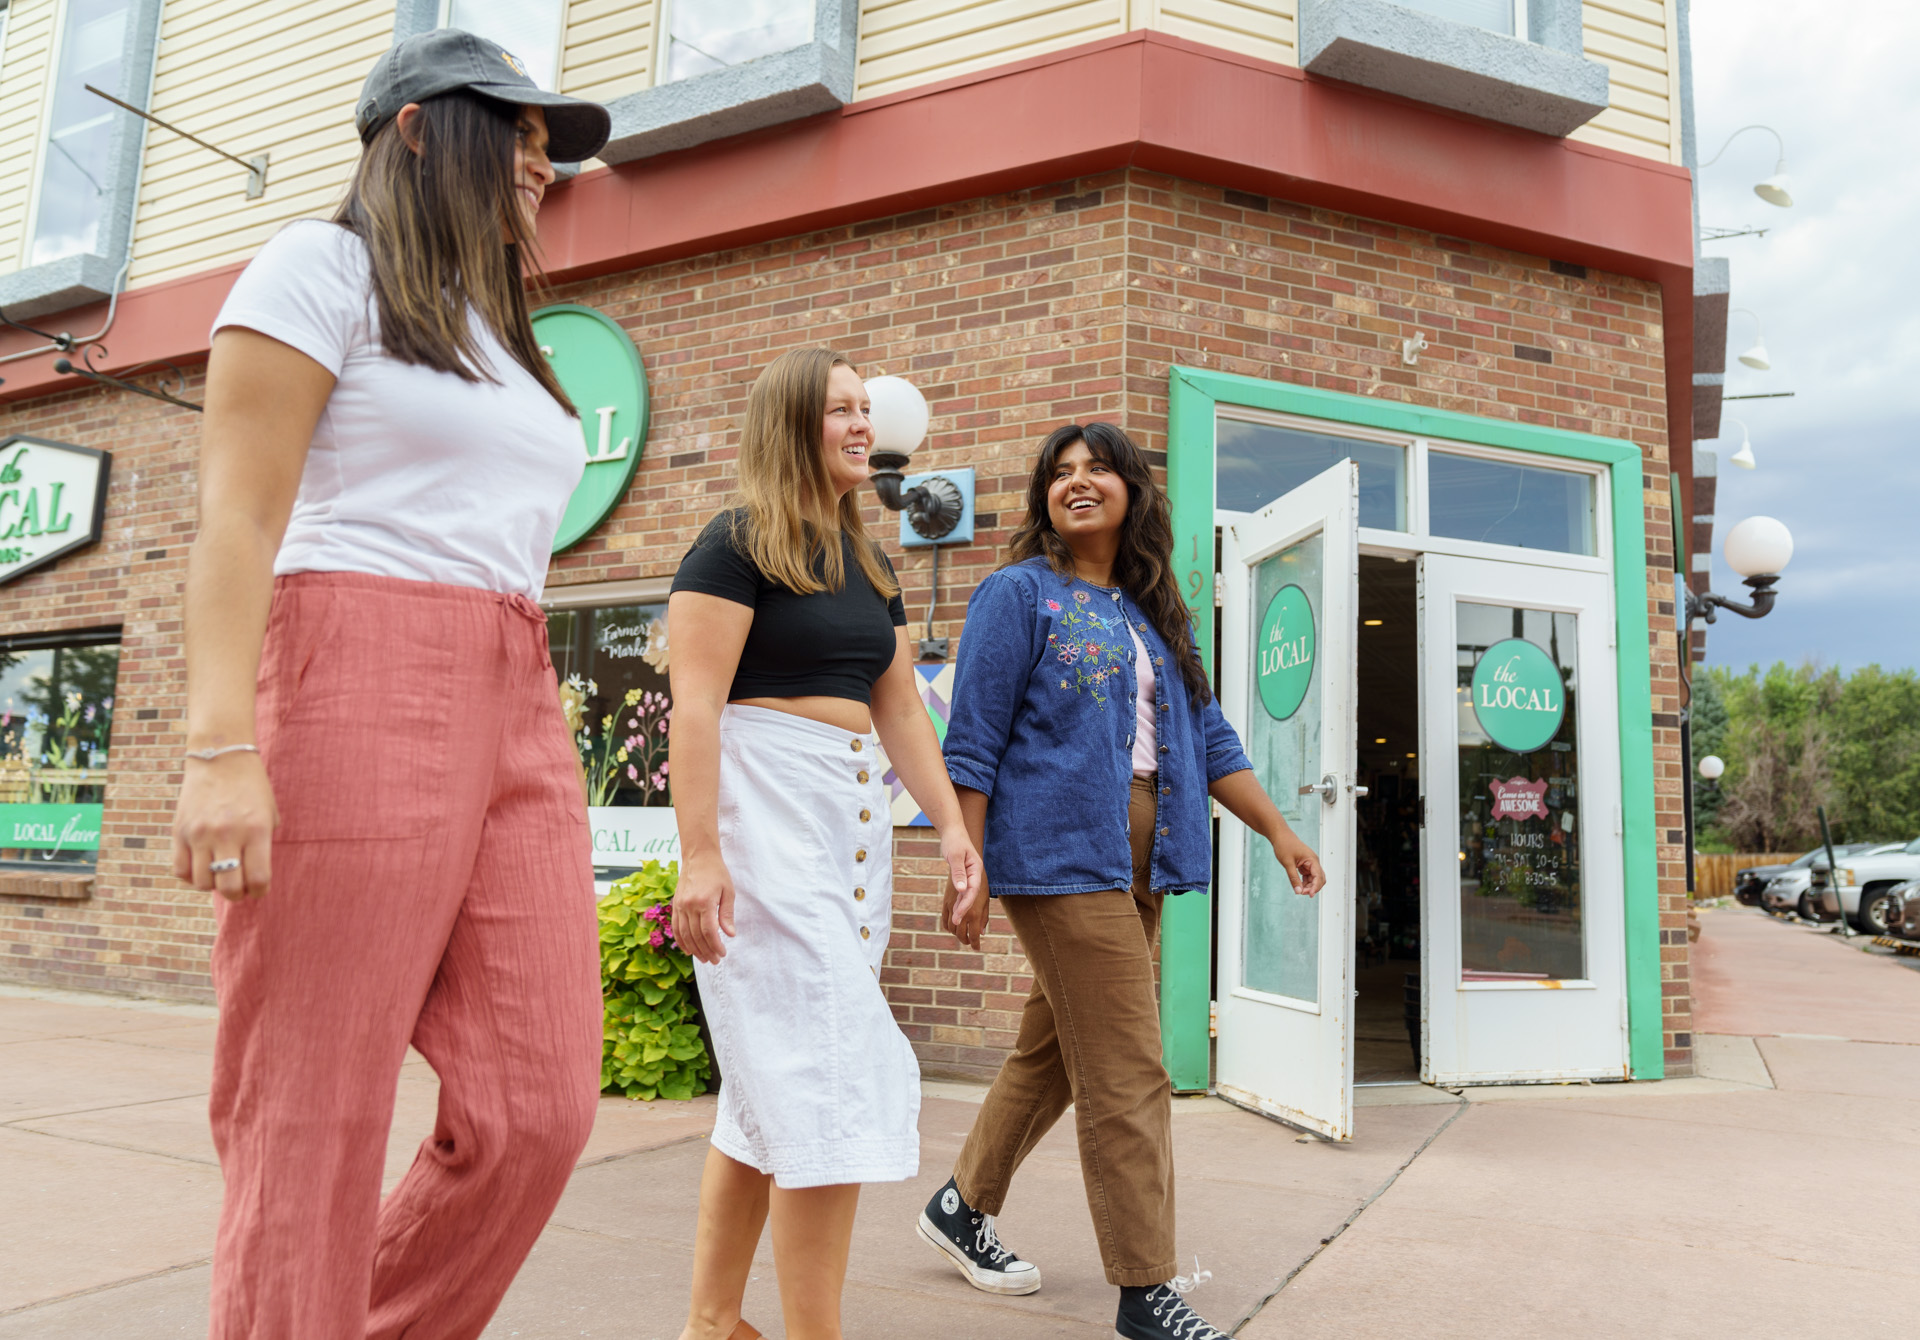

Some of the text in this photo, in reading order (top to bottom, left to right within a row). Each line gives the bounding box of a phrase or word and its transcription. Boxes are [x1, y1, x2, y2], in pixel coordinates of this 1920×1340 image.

[1269, 606, 1287, 643] the
[601, 637, 651, 659] Market
[1261, 635, 1311, 676] LOCAL
[1493, 655, 1520, 683] the
[1480, 684, 1558, 712] LOCAL
[1497, 786, 1517, 799] Come
[1518, 789, 1526, 799] in
[1500, 799, 1541, 812] AWESOME
[13, 812, 99, 860] LOCAL flavor
[1511, 833, 1544, 849] HOURS
[1500, 871, 1520, 885] SUN
